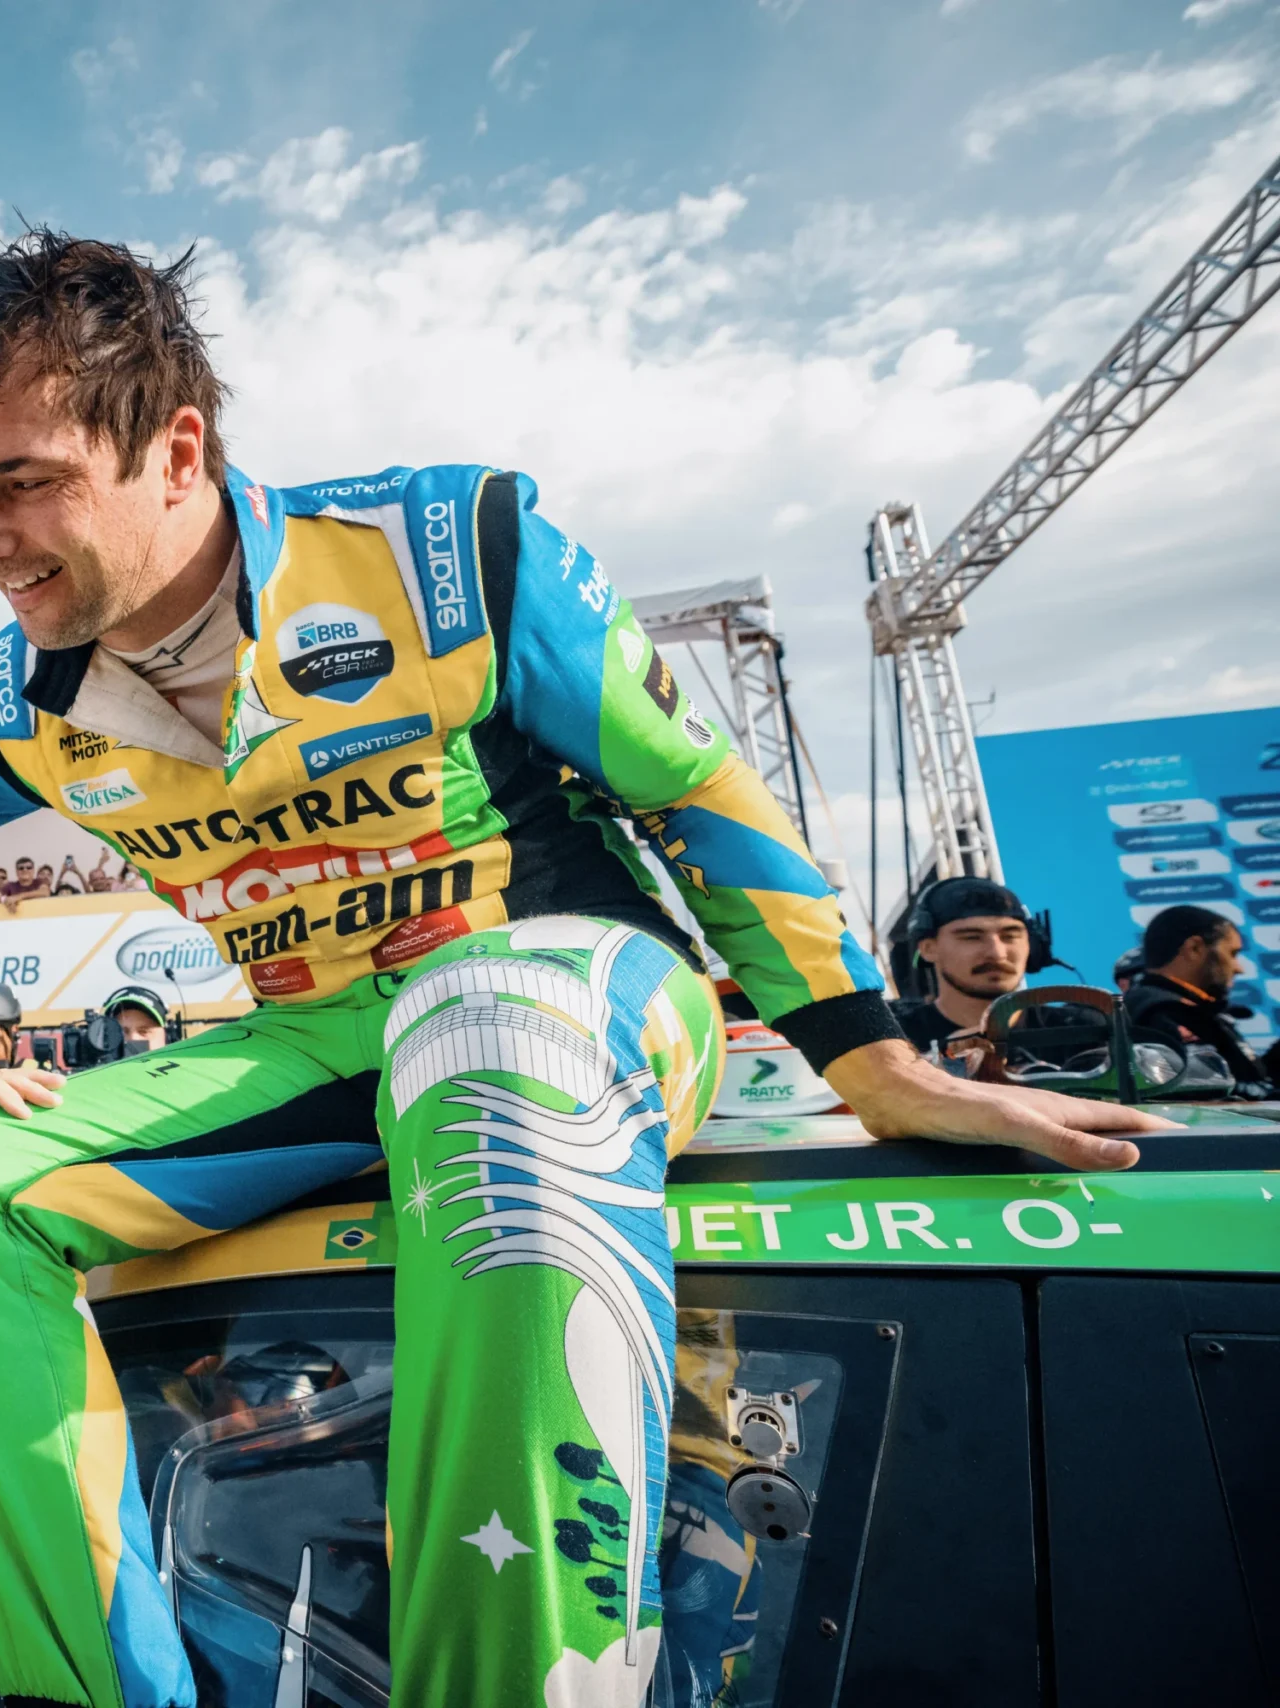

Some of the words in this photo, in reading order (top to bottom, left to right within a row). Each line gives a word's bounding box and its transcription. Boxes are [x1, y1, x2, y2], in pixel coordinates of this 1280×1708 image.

[424, 502, 466, 630] sparco
[316, 622, 359, 643] BRB
[59, 731, 106, 750] MITSU
[331, 728, 428, 759] VENTISOL
[69, 784, 137, 811] SOFISA
[113, 763, 436, 860] AUTOTRAC
[224, 859, 474, 962] can-am
[382, 922, 456, 956] PADDOCKFAN
[739, 1084, 795, 1098] PRATYC
[825, 1202, 973, 1249] JR.
